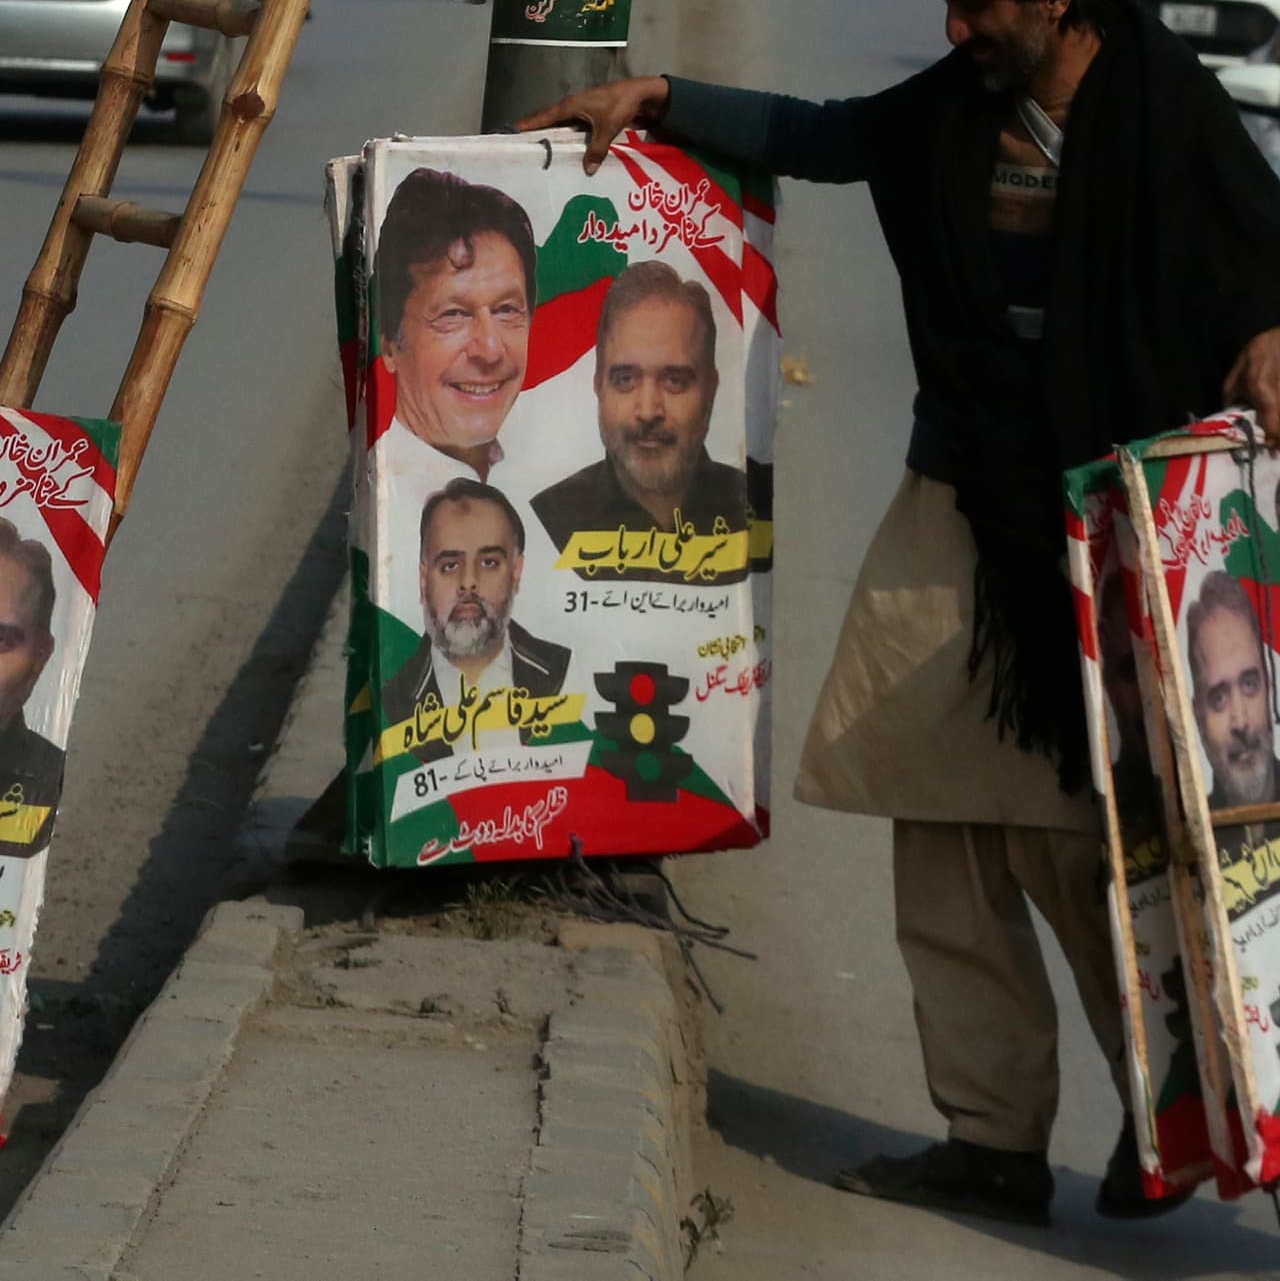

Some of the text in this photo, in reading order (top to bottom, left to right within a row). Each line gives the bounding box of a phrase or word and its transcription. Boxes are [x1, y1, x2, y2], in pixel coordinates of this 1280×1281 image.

[629, 179, 709, 215] عمران خان
[578, 204, 725, 254] کے نامزد امیدوار
[25, 438, 88, 474] عمران
[48, 467, 94, 508] کے
[578, 508, 730, 580] شیر علی ارباب
[689, 595, 729, 618] امیدوار
[403, 673, 568, 750] سید قاسم علی شاہ
[454, 758, 471, 782] کے
[524, 755, 562, 774] امیدوار
